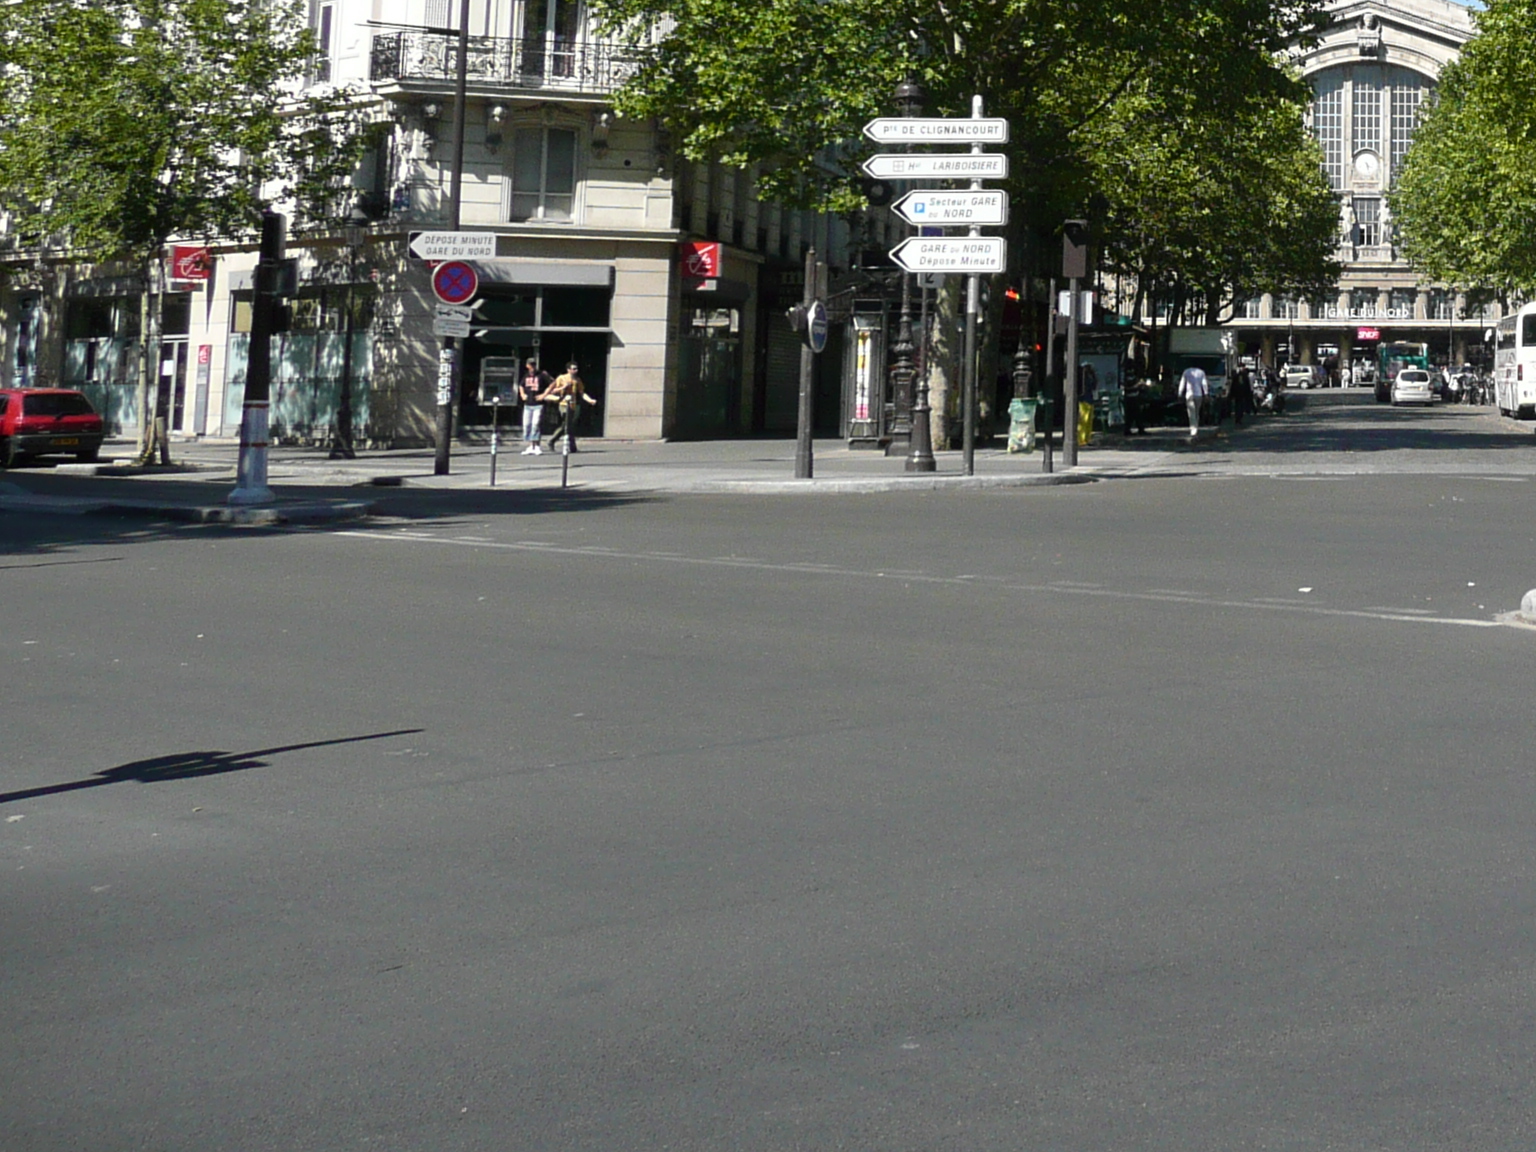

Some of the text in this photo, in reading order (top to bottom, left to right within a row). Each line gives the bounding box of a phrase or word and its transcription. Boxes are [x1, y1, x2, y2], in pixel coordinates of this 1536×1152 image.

[902, 126, 915, 135] DE
[920, 126, 999, 135] CLIGNANCOURT
[929, 197, 967, 207] Secteur
[971, 197, 998, 206] GARE
[943, 209, 973, 218] NORD
[461, 235, 494, 245] MINUTE
[452, 247, 464, 256] DU
[468, 247, 491, 256] NORD
[920, 244, 947, 254] GARE
[962, 244, 992, 254] NORD
[960, 256, 996, 265] Minute
[1328, 307, 1410, 319] GARE DU NORD
[1357, 330, 1380, 340] SNCF
